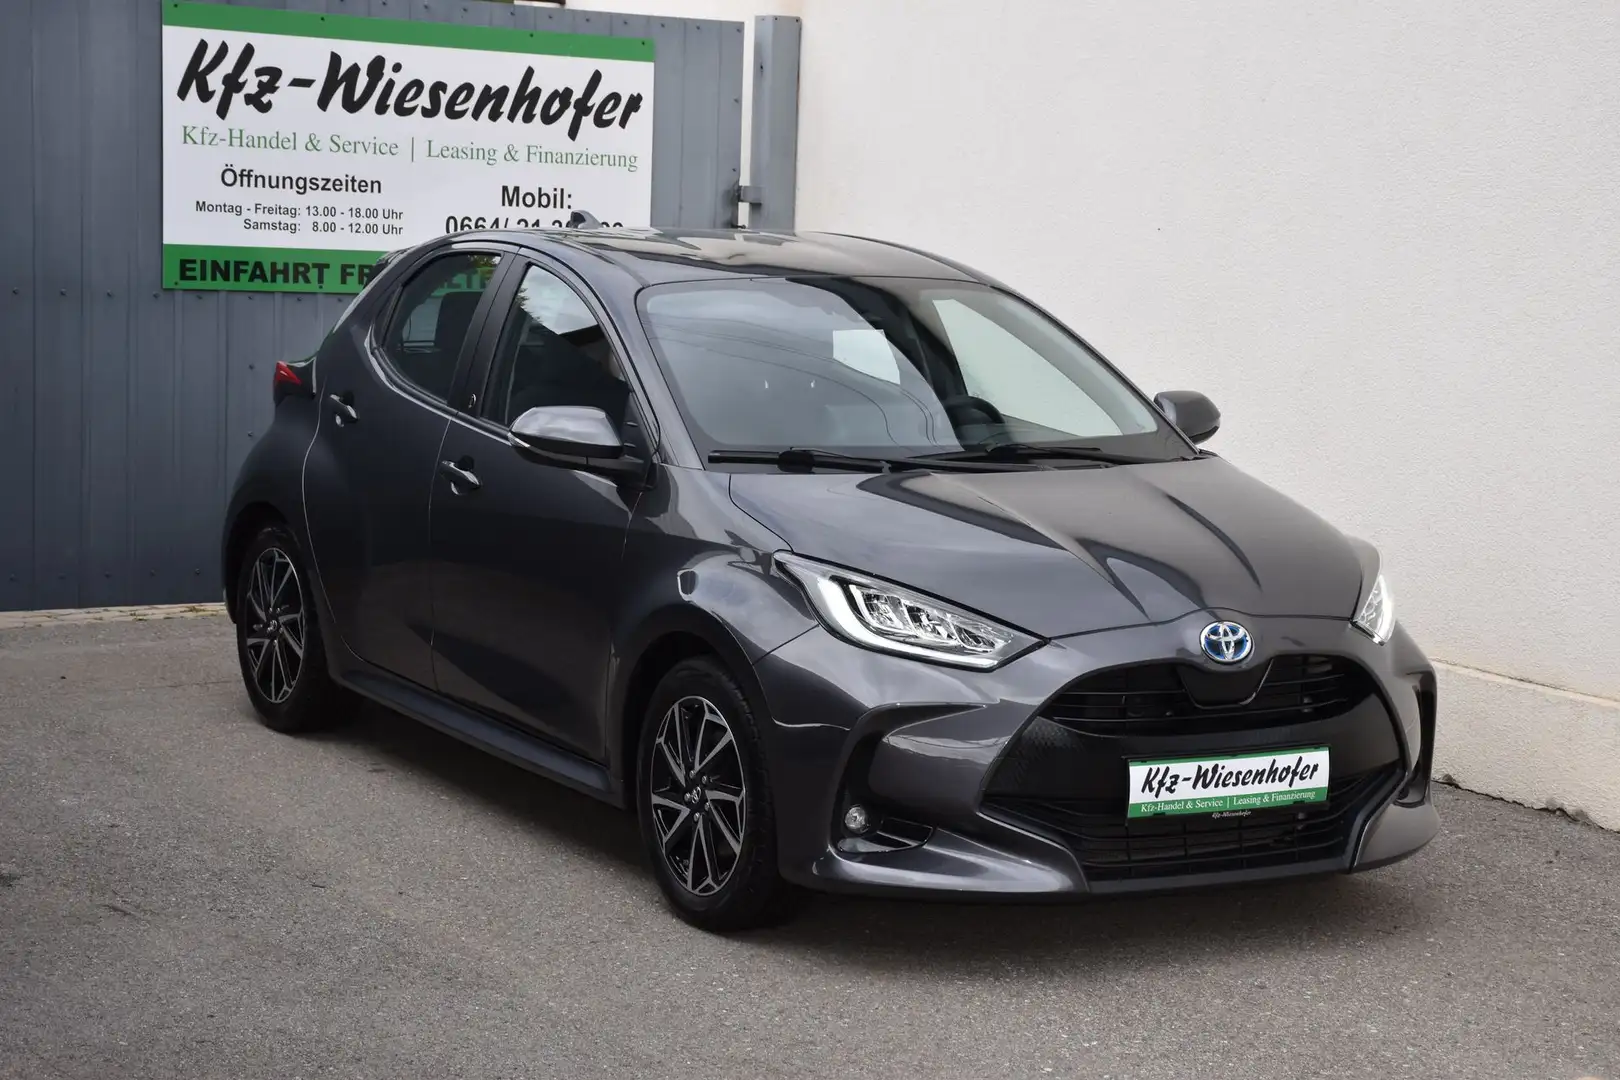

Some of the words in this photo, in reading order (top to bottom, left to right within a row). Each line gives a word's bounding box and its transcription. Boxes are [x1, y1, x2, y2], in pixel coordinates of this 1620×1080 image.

[177, 37, 644, 142] Kfz-Wiesenhofer
[182, 125, 297, 151] Kfz-Handel
[304, 132, 321, 152] &
[329, 134, 399, 156] Service
[427, 139, 497, 165] Leasing
[503, 143, 519, 162] &
[526, 145, 638, 172] Finanzierung
[220, 164, 382, 195] Öffnungszeiten
[195, 200, 243, 216] Montag
[254, 203, 301, 219] Freitag:
[305, 205, 337, 218] 13.00
[348, 207, 379, 219] 18.00
[382, 208, 404, 220] Uhr
[501, 185, 572, 209] Mobil:
[243, 218, 301, 233] Samstag:
[311, 221, 337, 233] 8.00
[348, 222, 379, 235] 12.00
[382, 223, 404, 235] Uhr
[179, 258, 330, 285] EINFAHRT
[1141, 755, 1319, 799] Kfz-Wiesenhofer
[1140, 802, 1184, 813] Kfz-Handel
[1186, 801, 1193, 809] &
[1195, 798, 1224, 808] Service
[1233, 795, 1262, 806] Leasing
[1263, 794, 1270, 803] &
[1271, 790, 1316, 802] Finanzierung
